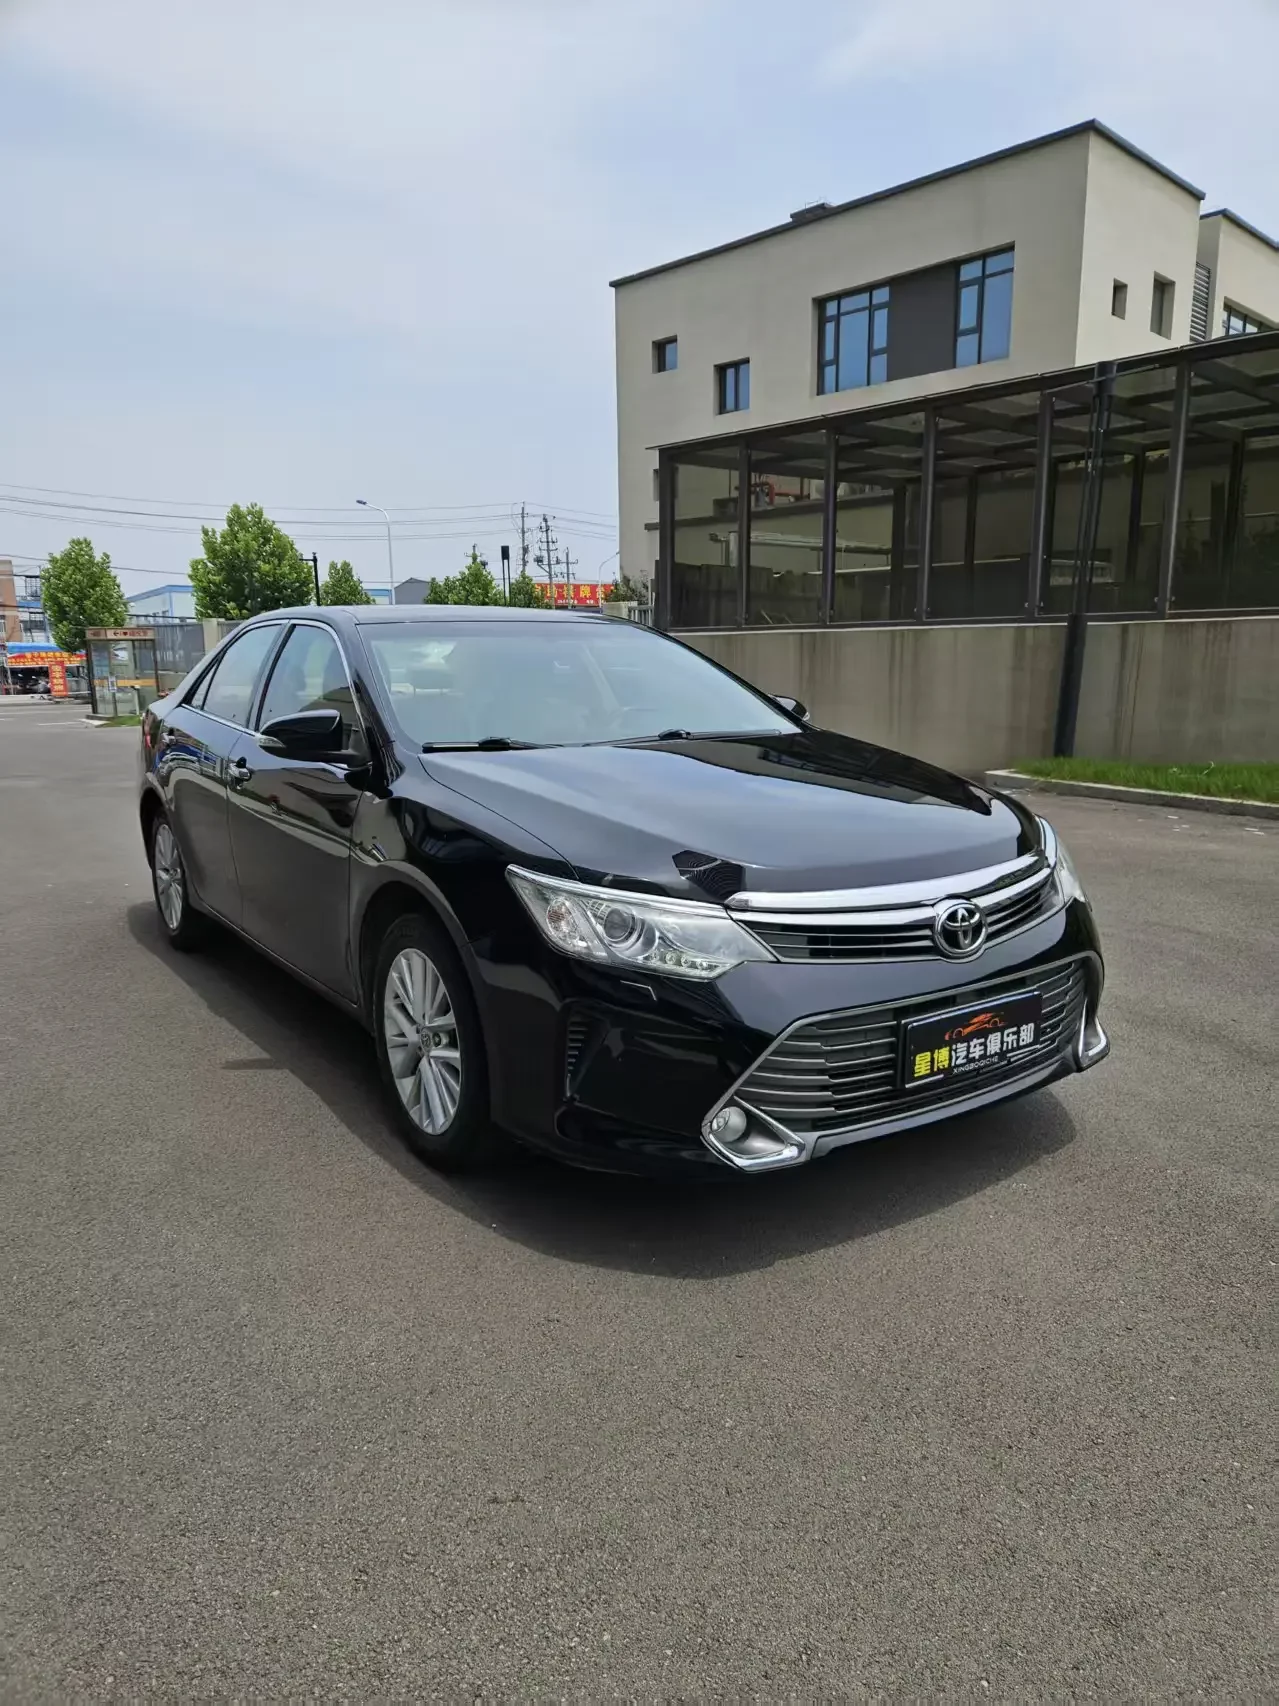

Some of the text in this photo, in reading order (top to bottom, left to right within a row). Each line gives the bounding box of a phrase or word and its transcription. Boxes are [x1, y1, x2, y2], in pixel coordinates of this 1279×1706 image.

[913, 1022, 1035, 1078] 星博汽车俱乐部
[952, 1056, 999, 1075] XINGBOQICHE
